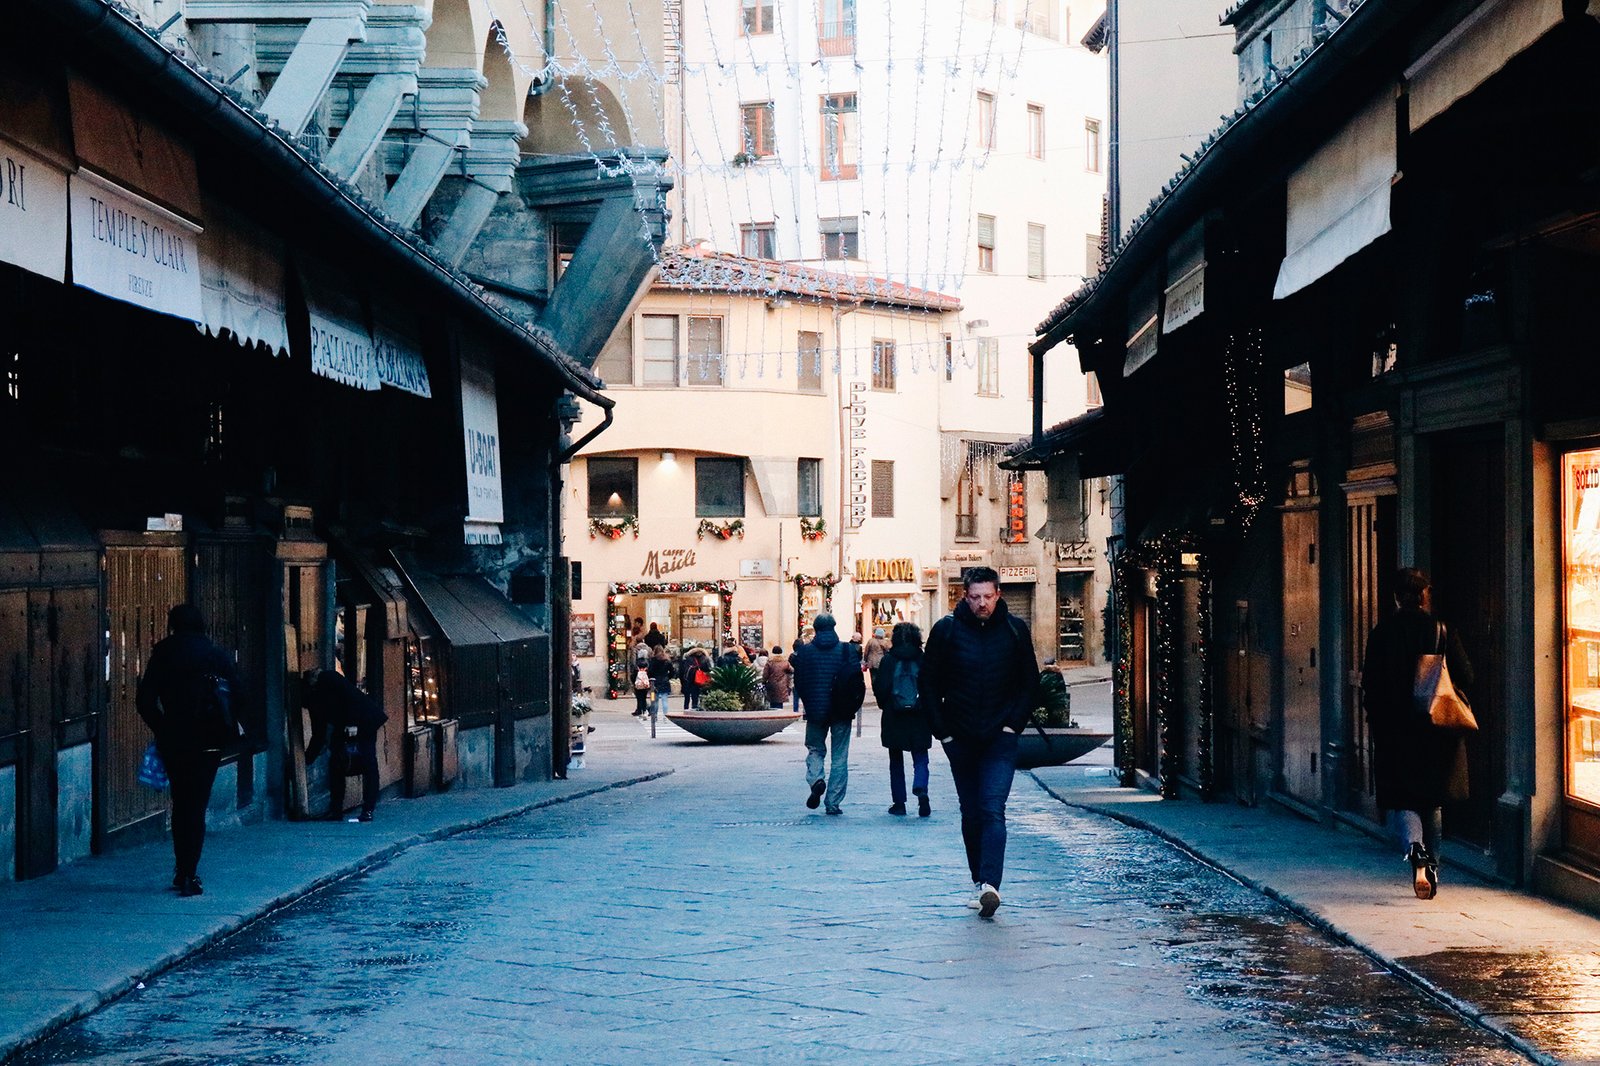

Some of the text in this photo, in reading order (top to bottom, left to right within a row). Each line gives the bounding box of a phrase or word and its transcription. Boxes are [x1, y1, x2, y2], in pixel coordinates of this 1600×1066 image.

[0, 157, 26, 212] RI
[90, 197, 138, 255] TEMPLE
[152, 226, 188, 274] CLAIR
[851, 382, 866, 528] GLOVE FACTORY
[856, 558, 915, 582] MADOVA
[1001, 566, 1036, 577] PIZZERIA
